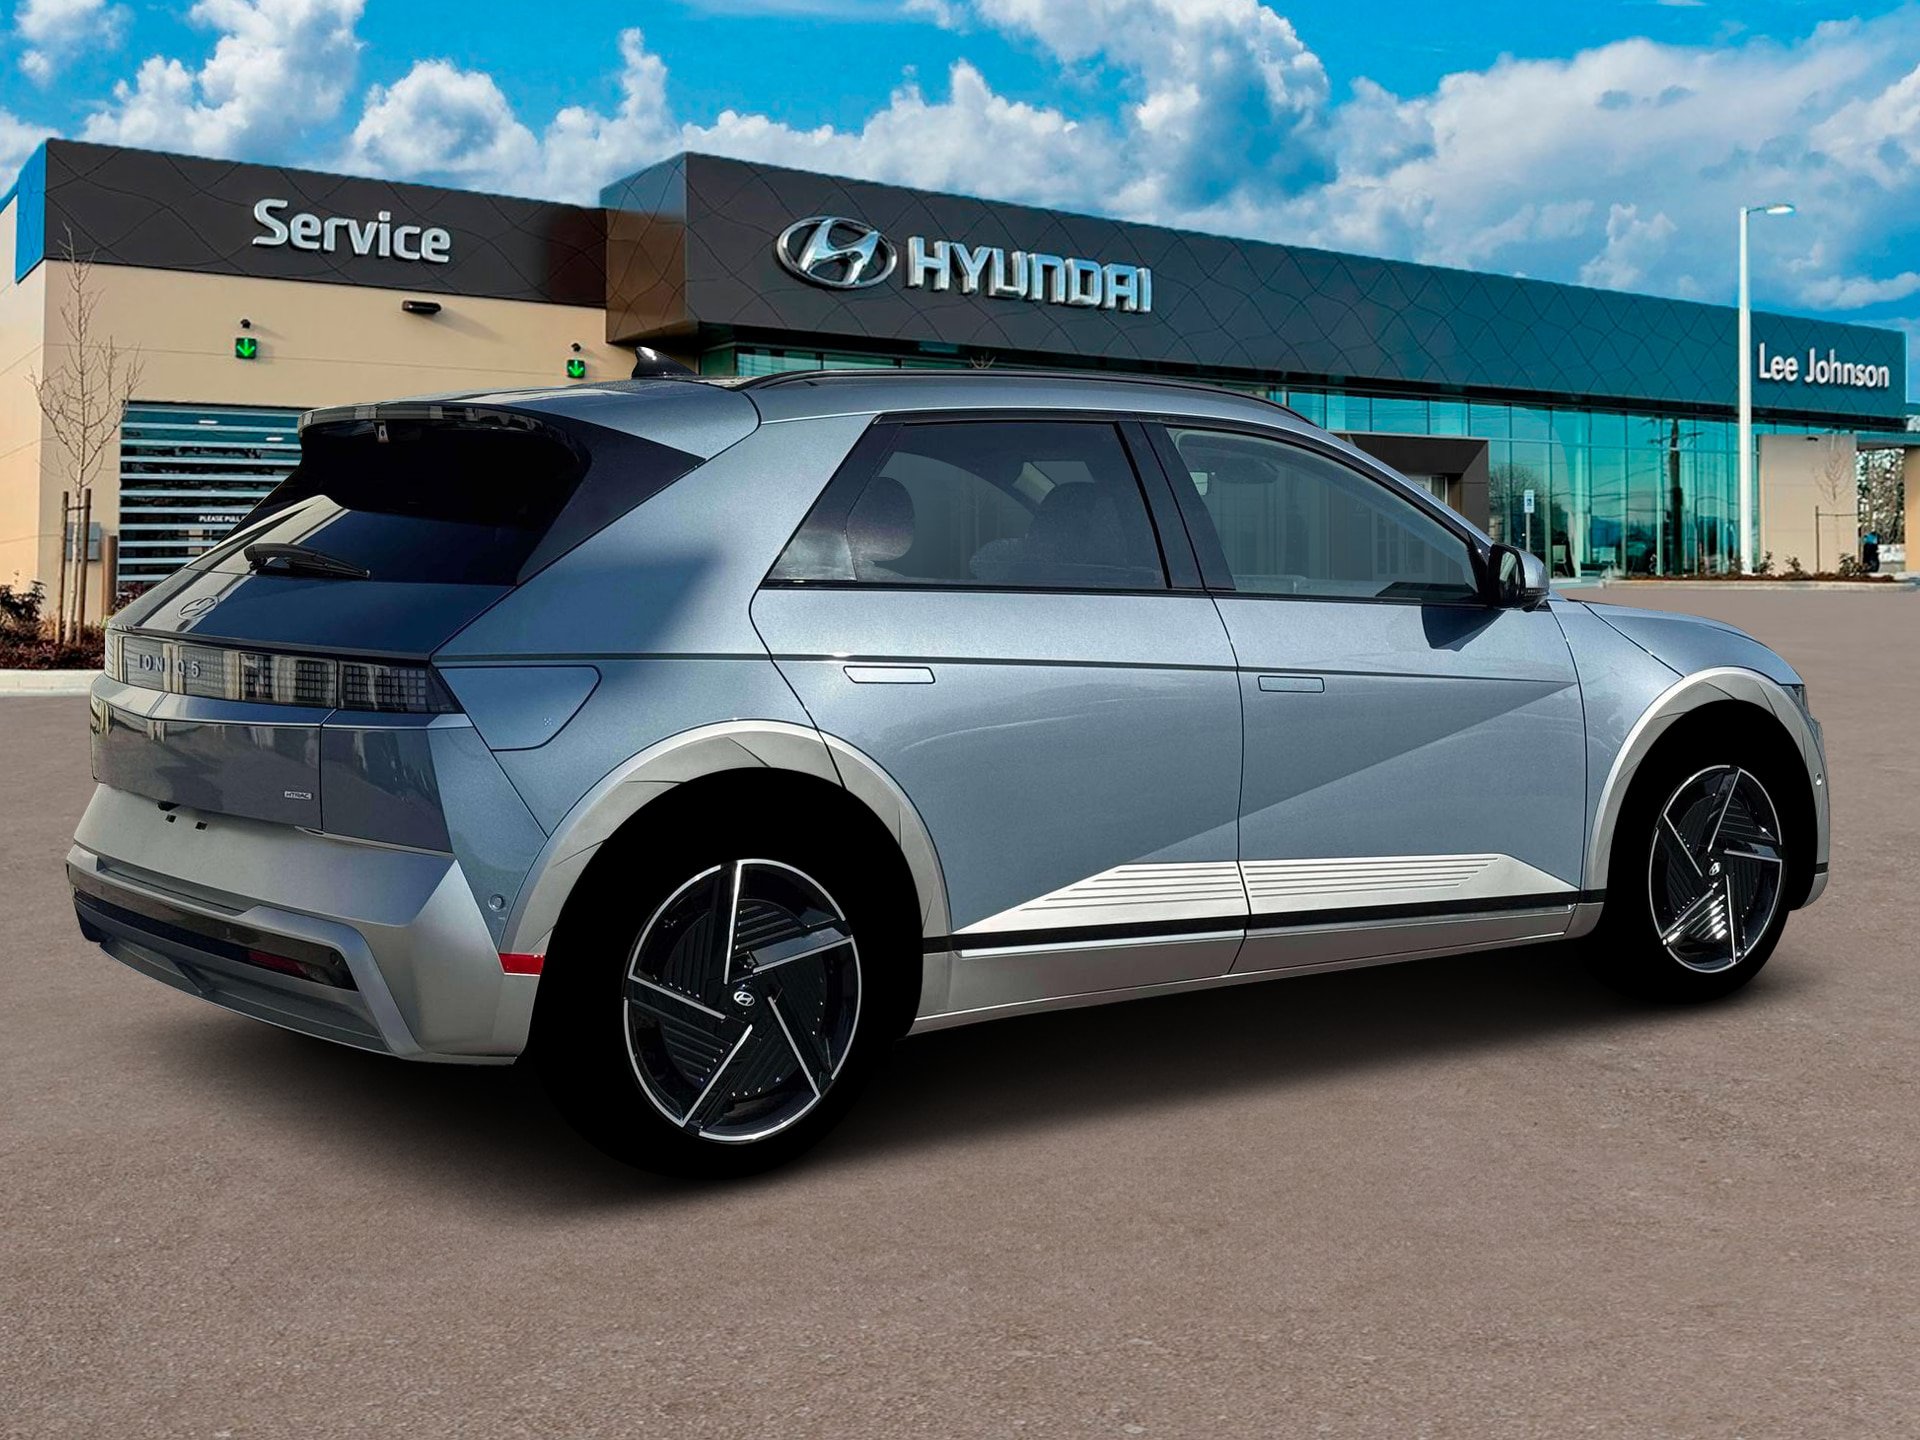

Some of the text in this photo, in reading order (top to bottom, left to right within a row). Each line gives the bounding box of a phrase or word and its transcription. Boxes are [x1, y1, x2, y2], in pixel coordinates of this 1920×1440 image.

[252, 198, 451, 263] Service
[907, 236, 1152, 313] HYUNDAI
[1758, 342, 1890, 388] Lee Johnson
[199, 514, 223, 522] PLEASE
[191, 661, 201, 678] 5
